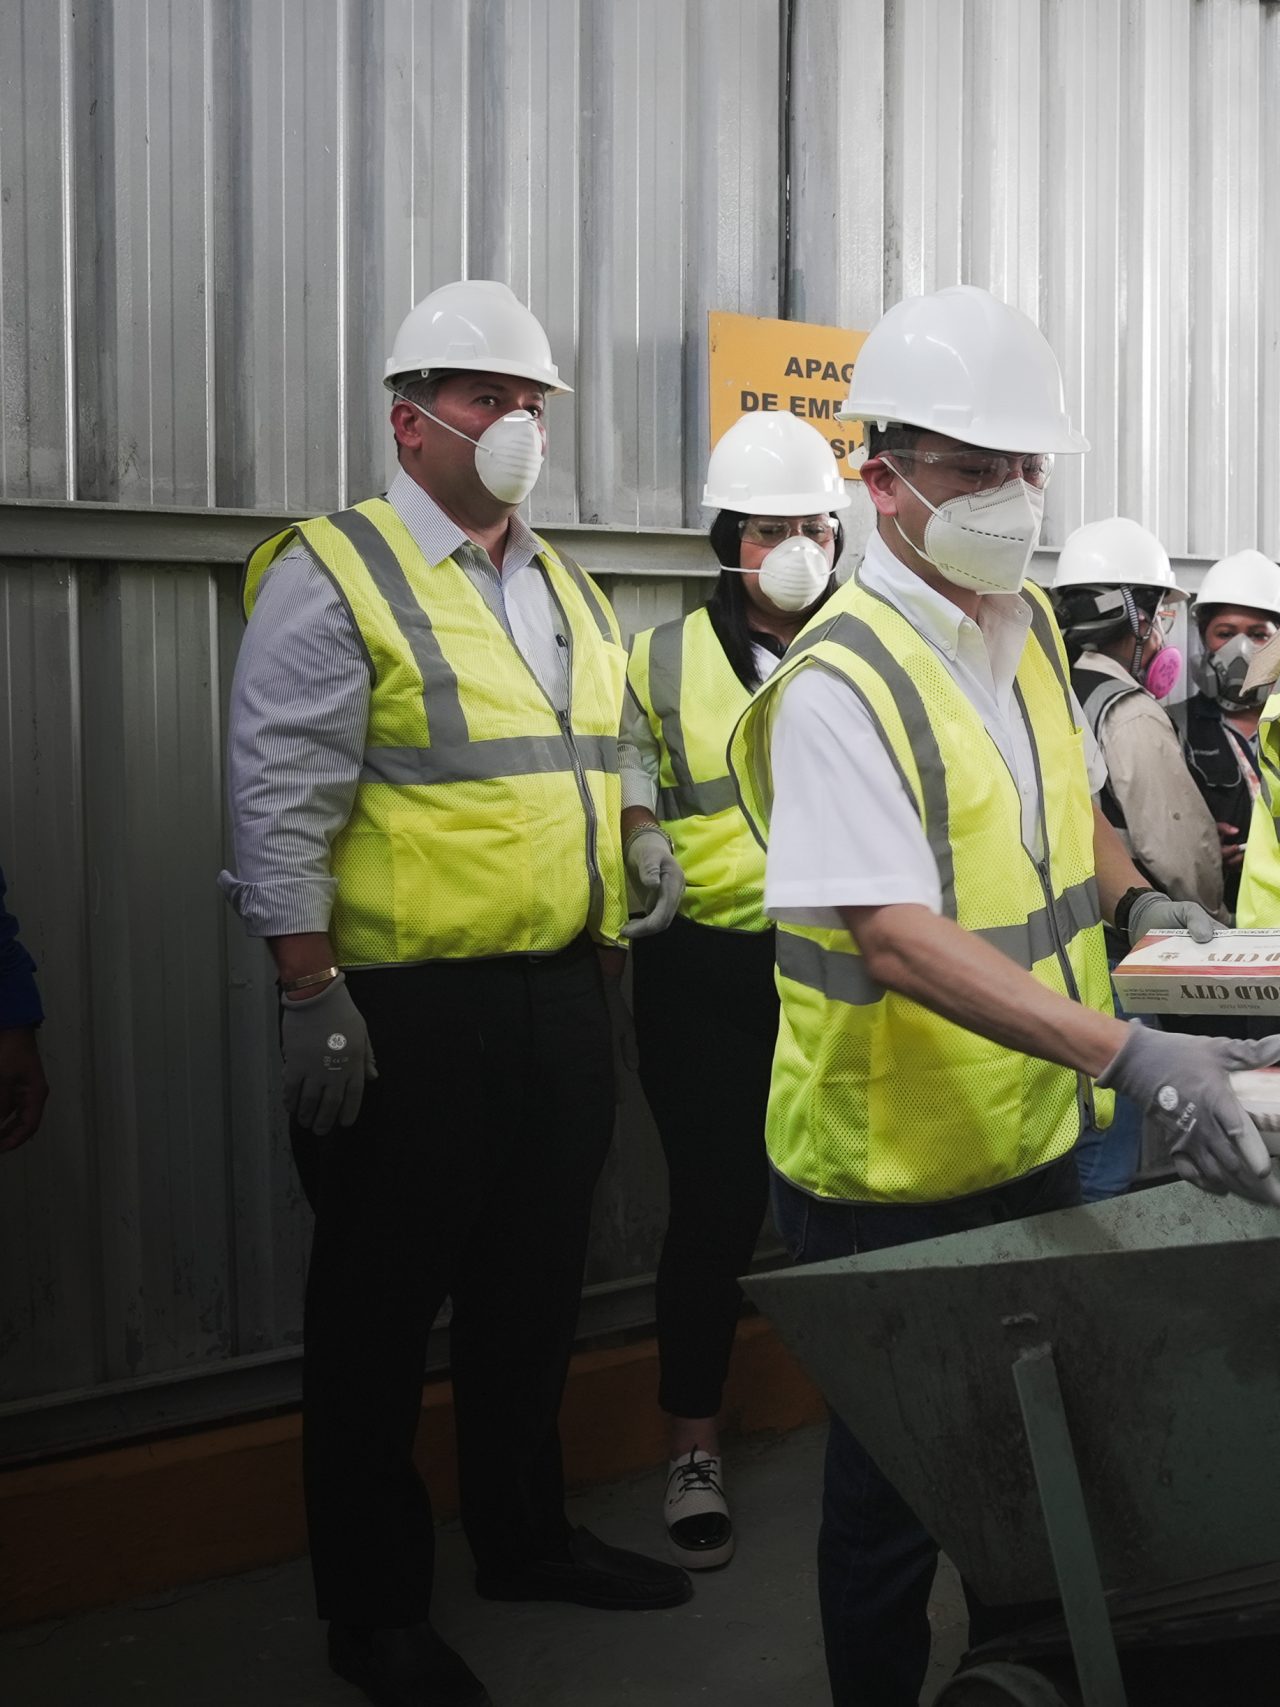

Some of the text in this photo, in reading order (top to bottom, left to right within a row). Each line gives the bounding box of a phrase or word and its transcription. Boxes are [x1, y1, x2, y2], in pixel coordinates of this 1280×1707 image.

[784, 356, 855, 384] APAG
[741, 390, 779, 411] DE
[1207, 951, 1262, 963] CITY
[1180, 984, 1230, 1000] CITY
